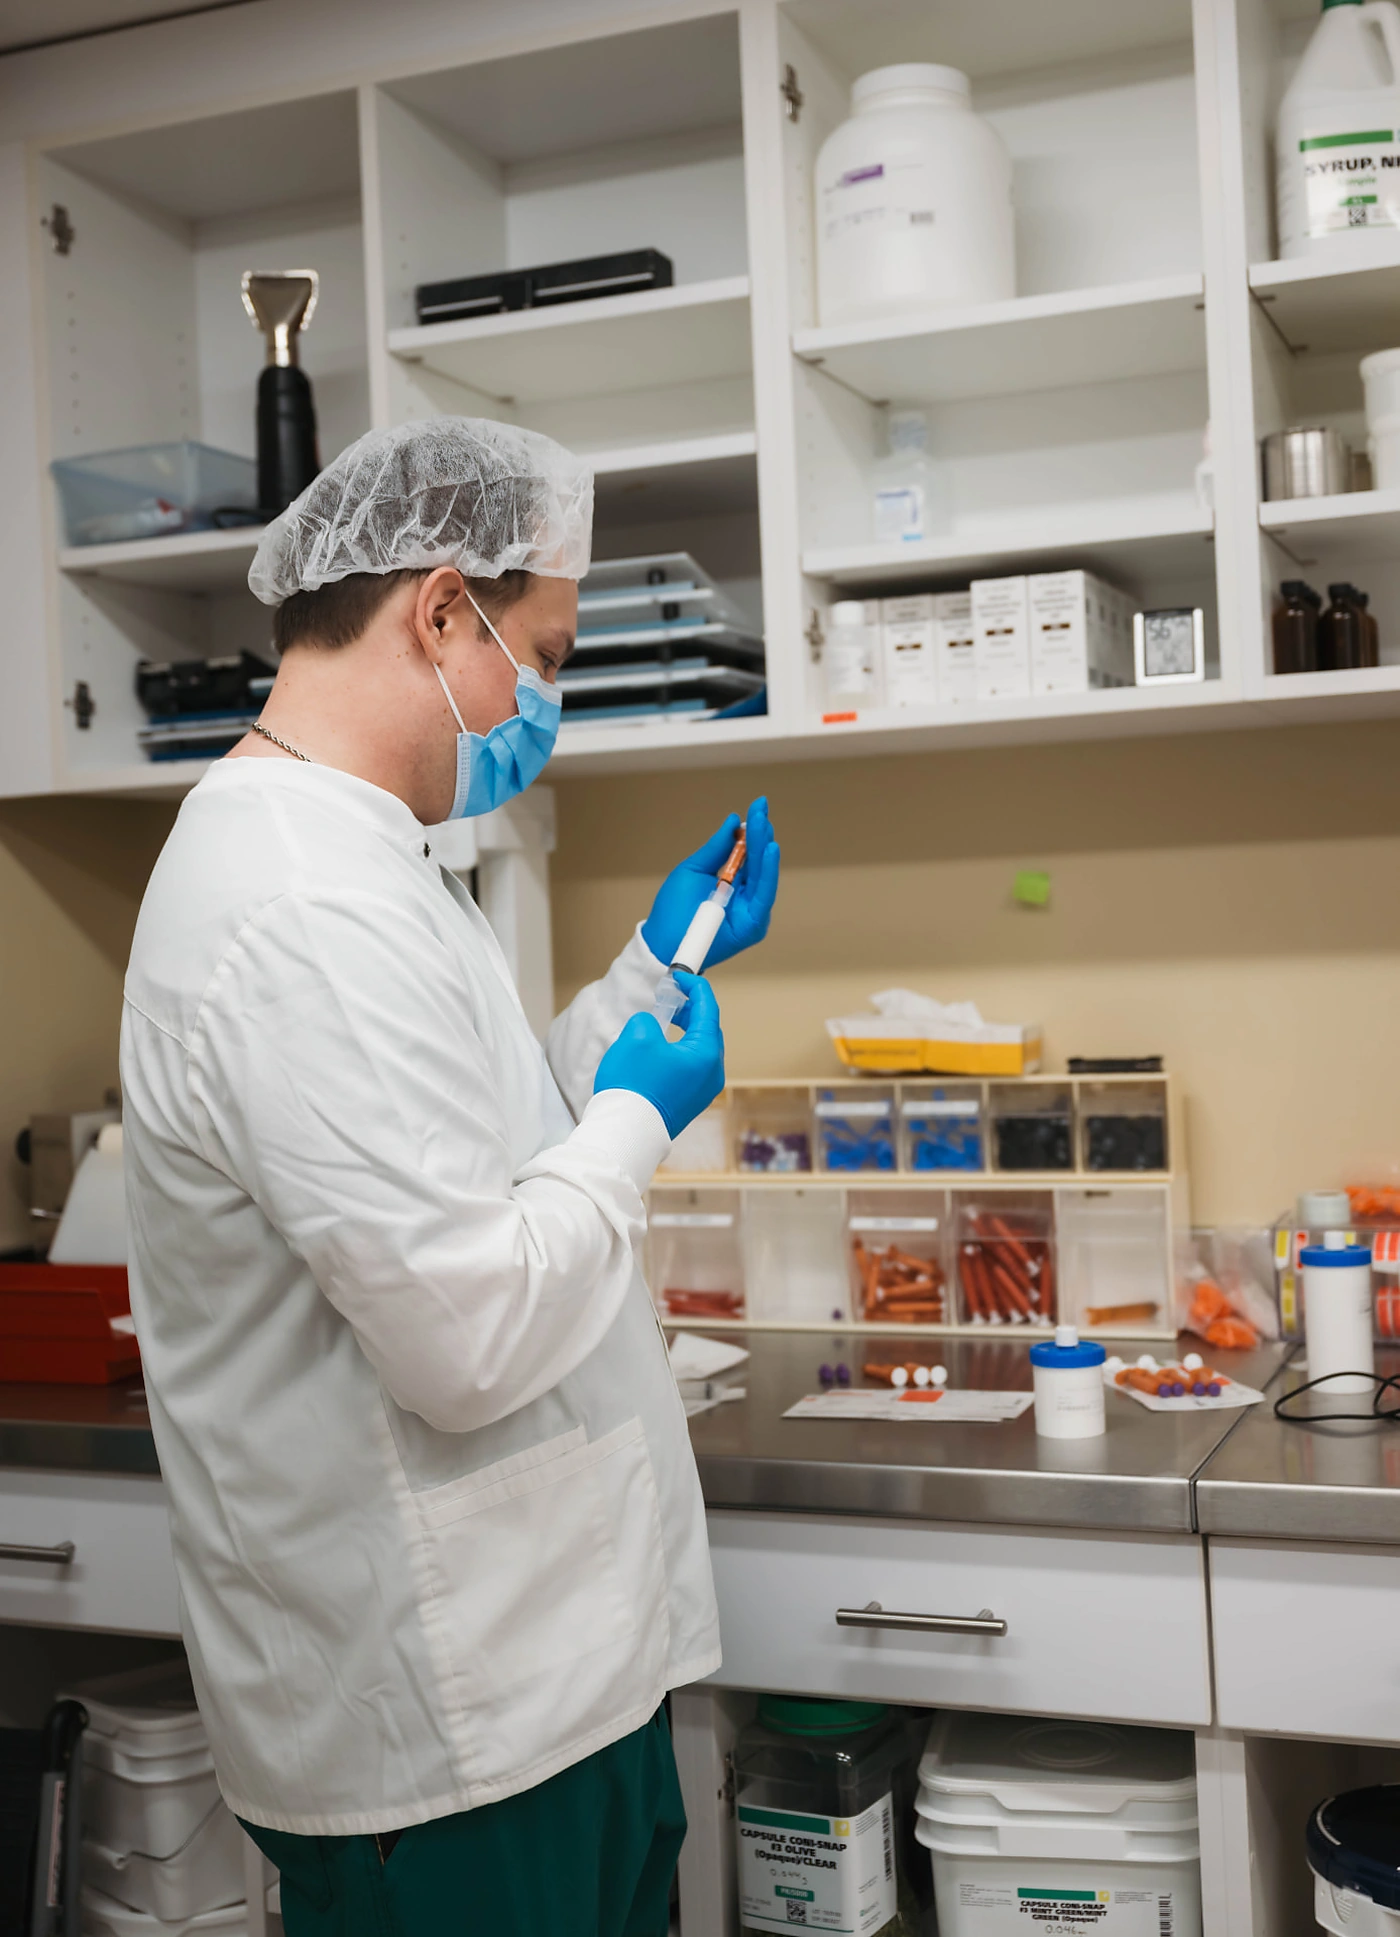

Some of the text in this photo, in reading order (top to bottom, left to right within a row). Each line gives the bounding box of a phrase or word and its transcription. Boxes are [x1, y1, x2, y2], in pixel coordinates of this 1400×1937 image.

[740, 1828, 847, 1851] CAPSULE CONI-SNAP
[785, 1845, 816, 1857] OLIVE
[1020, 1900, 1105, 1910] CAPSULE CONI-SNAP
[1062, 1915, 1098, 1923] (Opaque)
